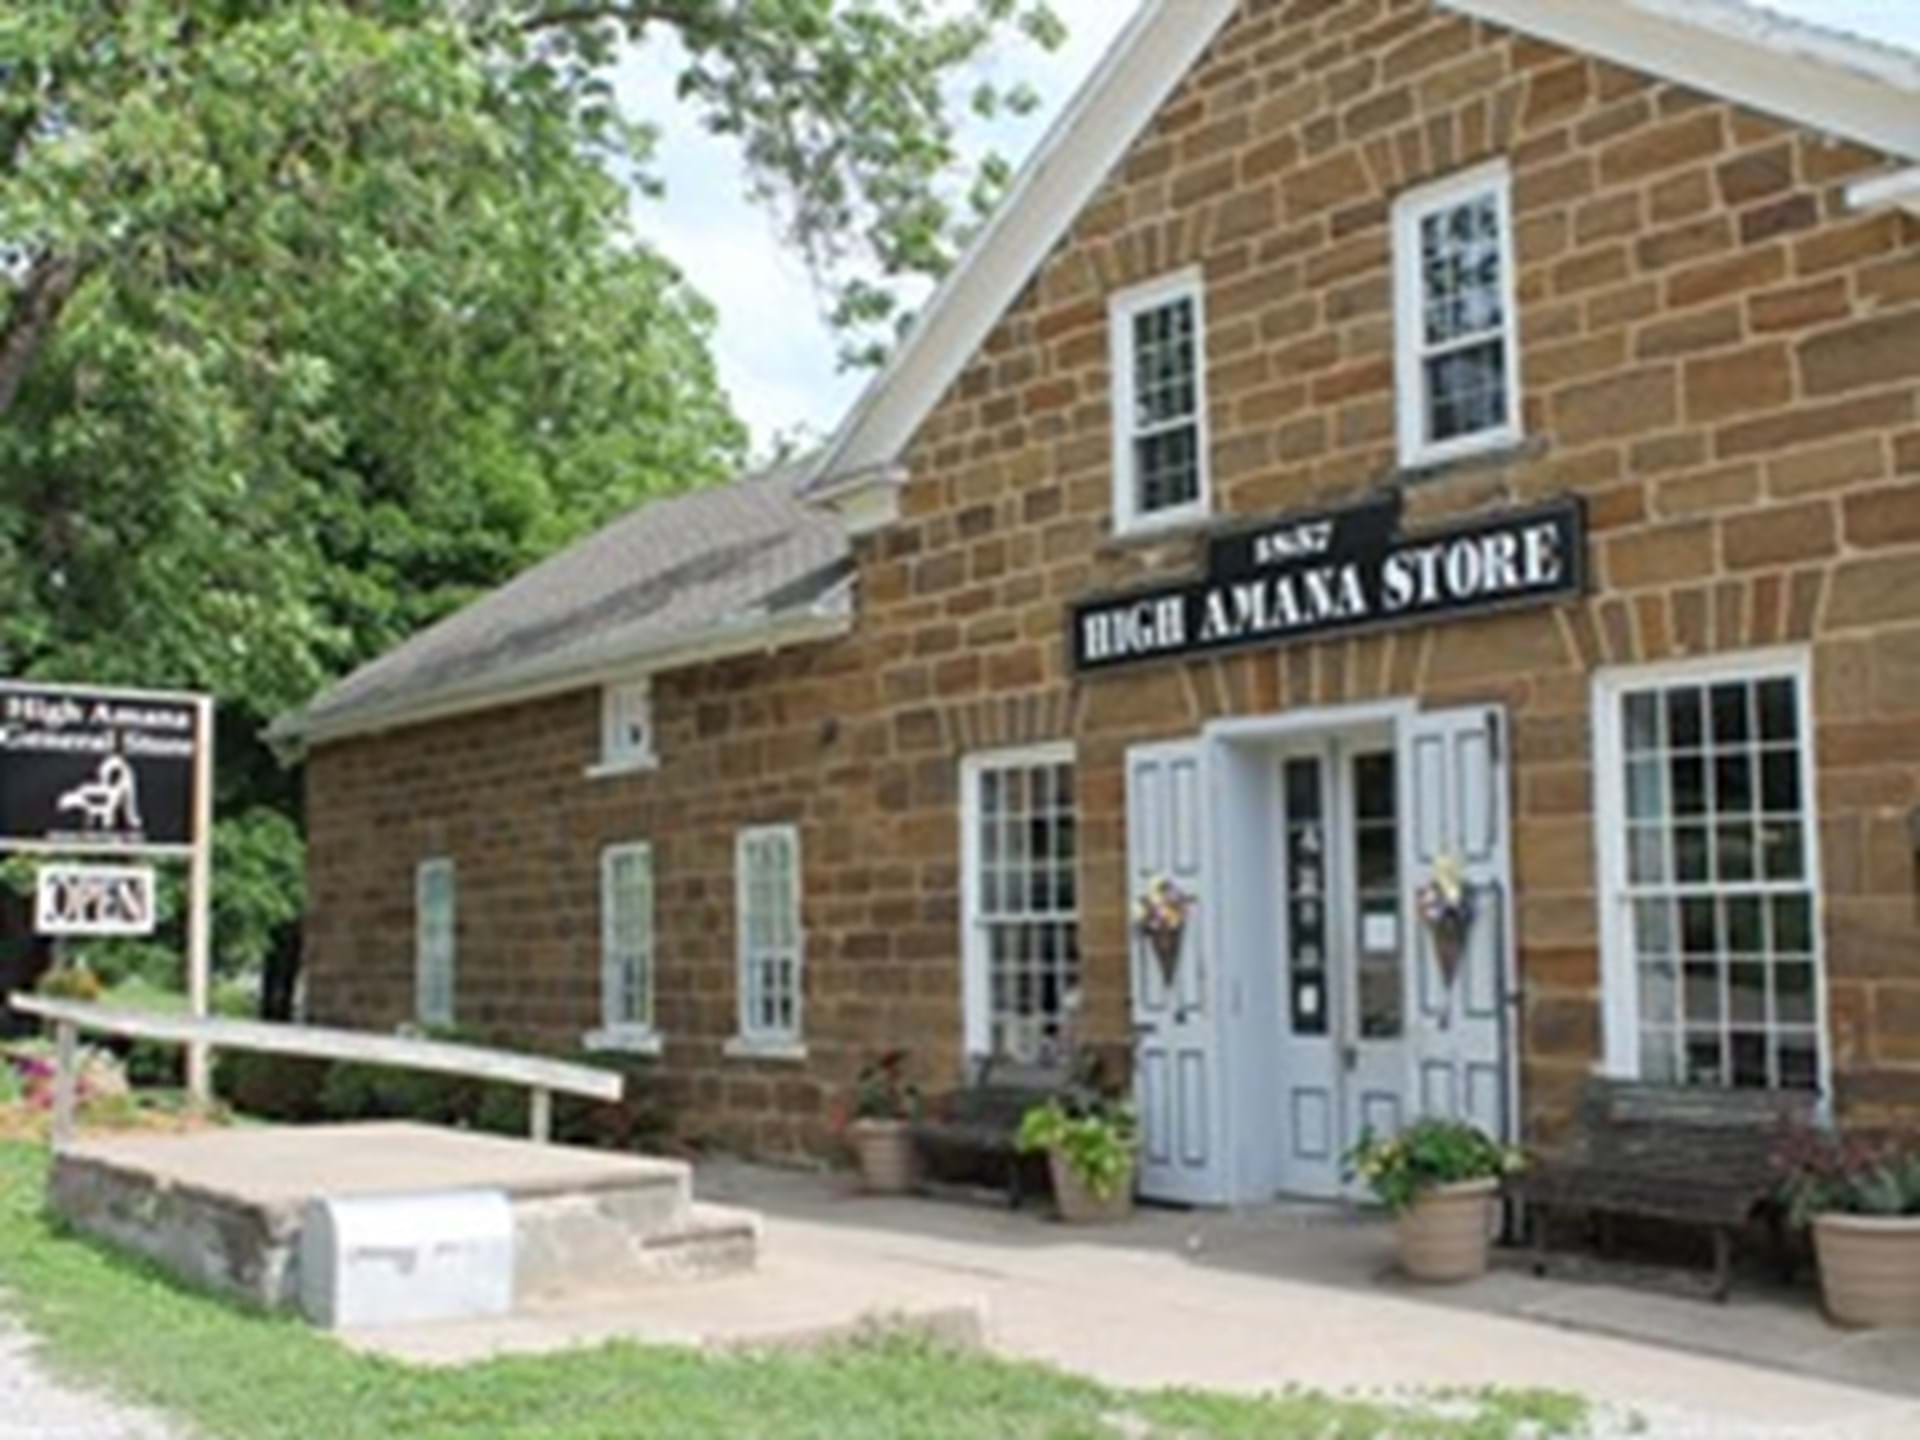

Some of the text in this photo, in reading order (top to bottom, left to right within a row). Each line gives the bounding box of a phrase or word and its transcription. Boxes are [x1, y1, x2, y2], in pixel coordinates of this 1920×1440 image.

[1083, 522, 1561, 660] HIGH AMANA STORE
[6, 697, 191, 731] High Amana
[44, 873, 148, 923] OPEN
